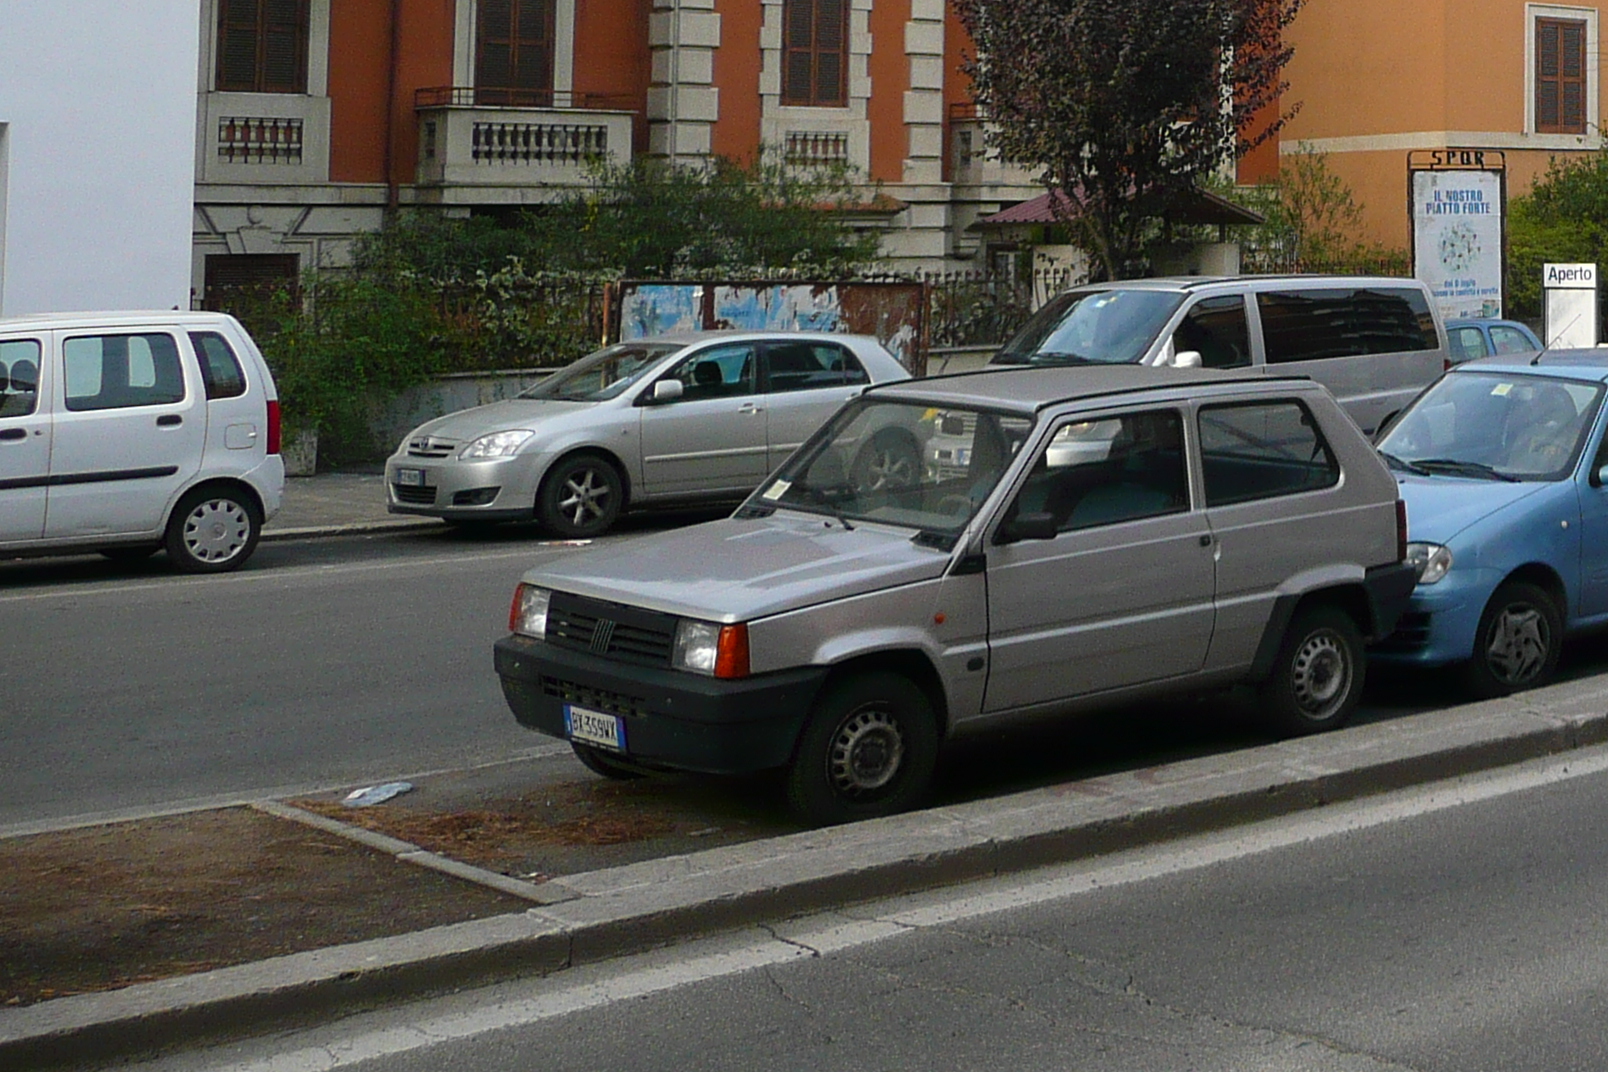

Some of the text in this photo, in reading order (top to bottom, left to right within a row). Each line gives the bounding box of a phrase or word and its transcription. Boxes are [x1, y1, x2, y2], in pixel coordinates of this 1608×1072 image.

[1431, 150, 1484, 166] SPQR
[1434, 189, 1483, 202] IL NOSTRO
[1426, 202, 1491, 215] PIATTO FORTE
[1548, 266, 1592, 284] Aperto
